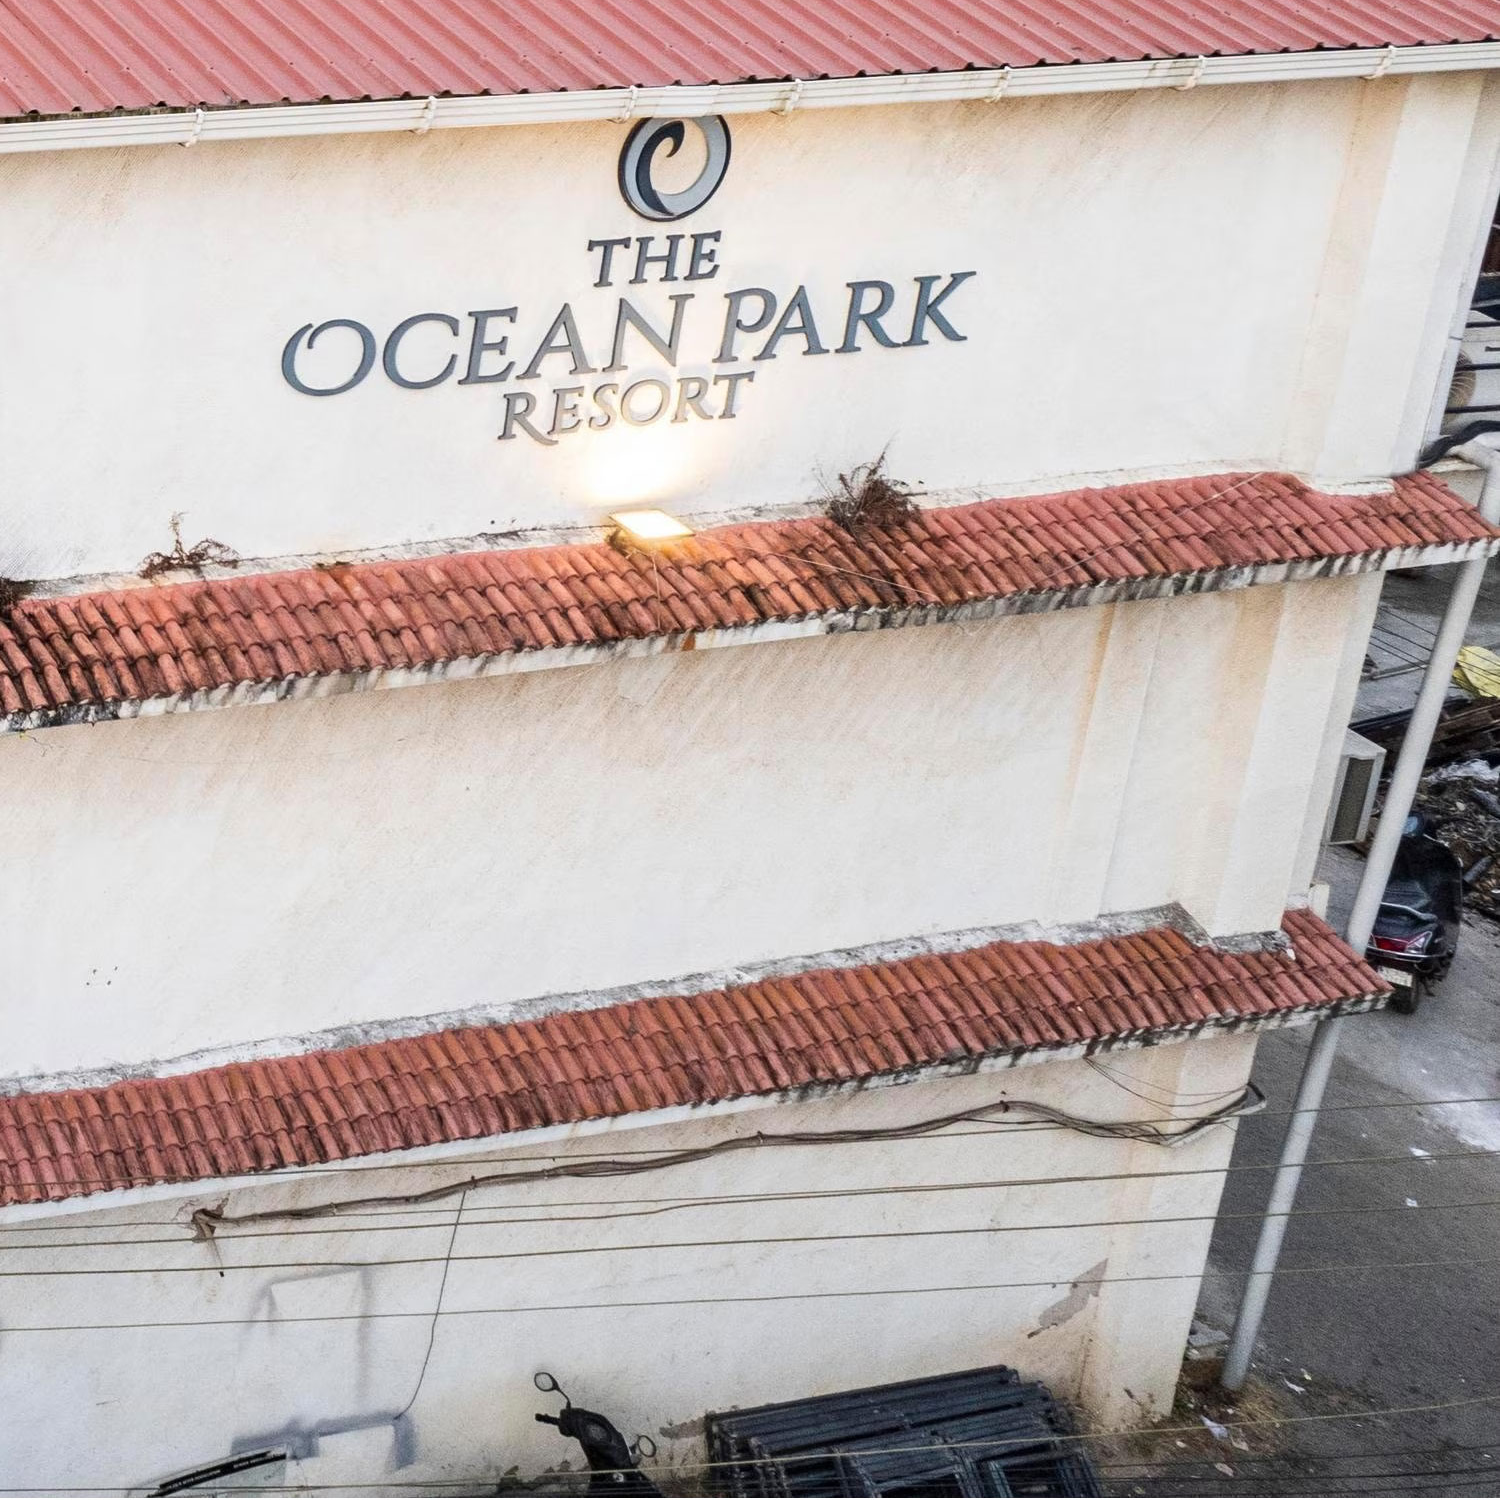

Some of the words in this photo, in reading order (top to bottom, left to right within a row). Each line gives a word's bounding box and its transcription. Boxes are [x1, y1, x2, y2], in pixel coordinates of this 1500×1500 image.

[586, 230, 723, 288] THE
[280, 292, 695, 397] OCEAN
[713, 270, 978, 364] PARK
[497, 370, 756, 446] RESORT
